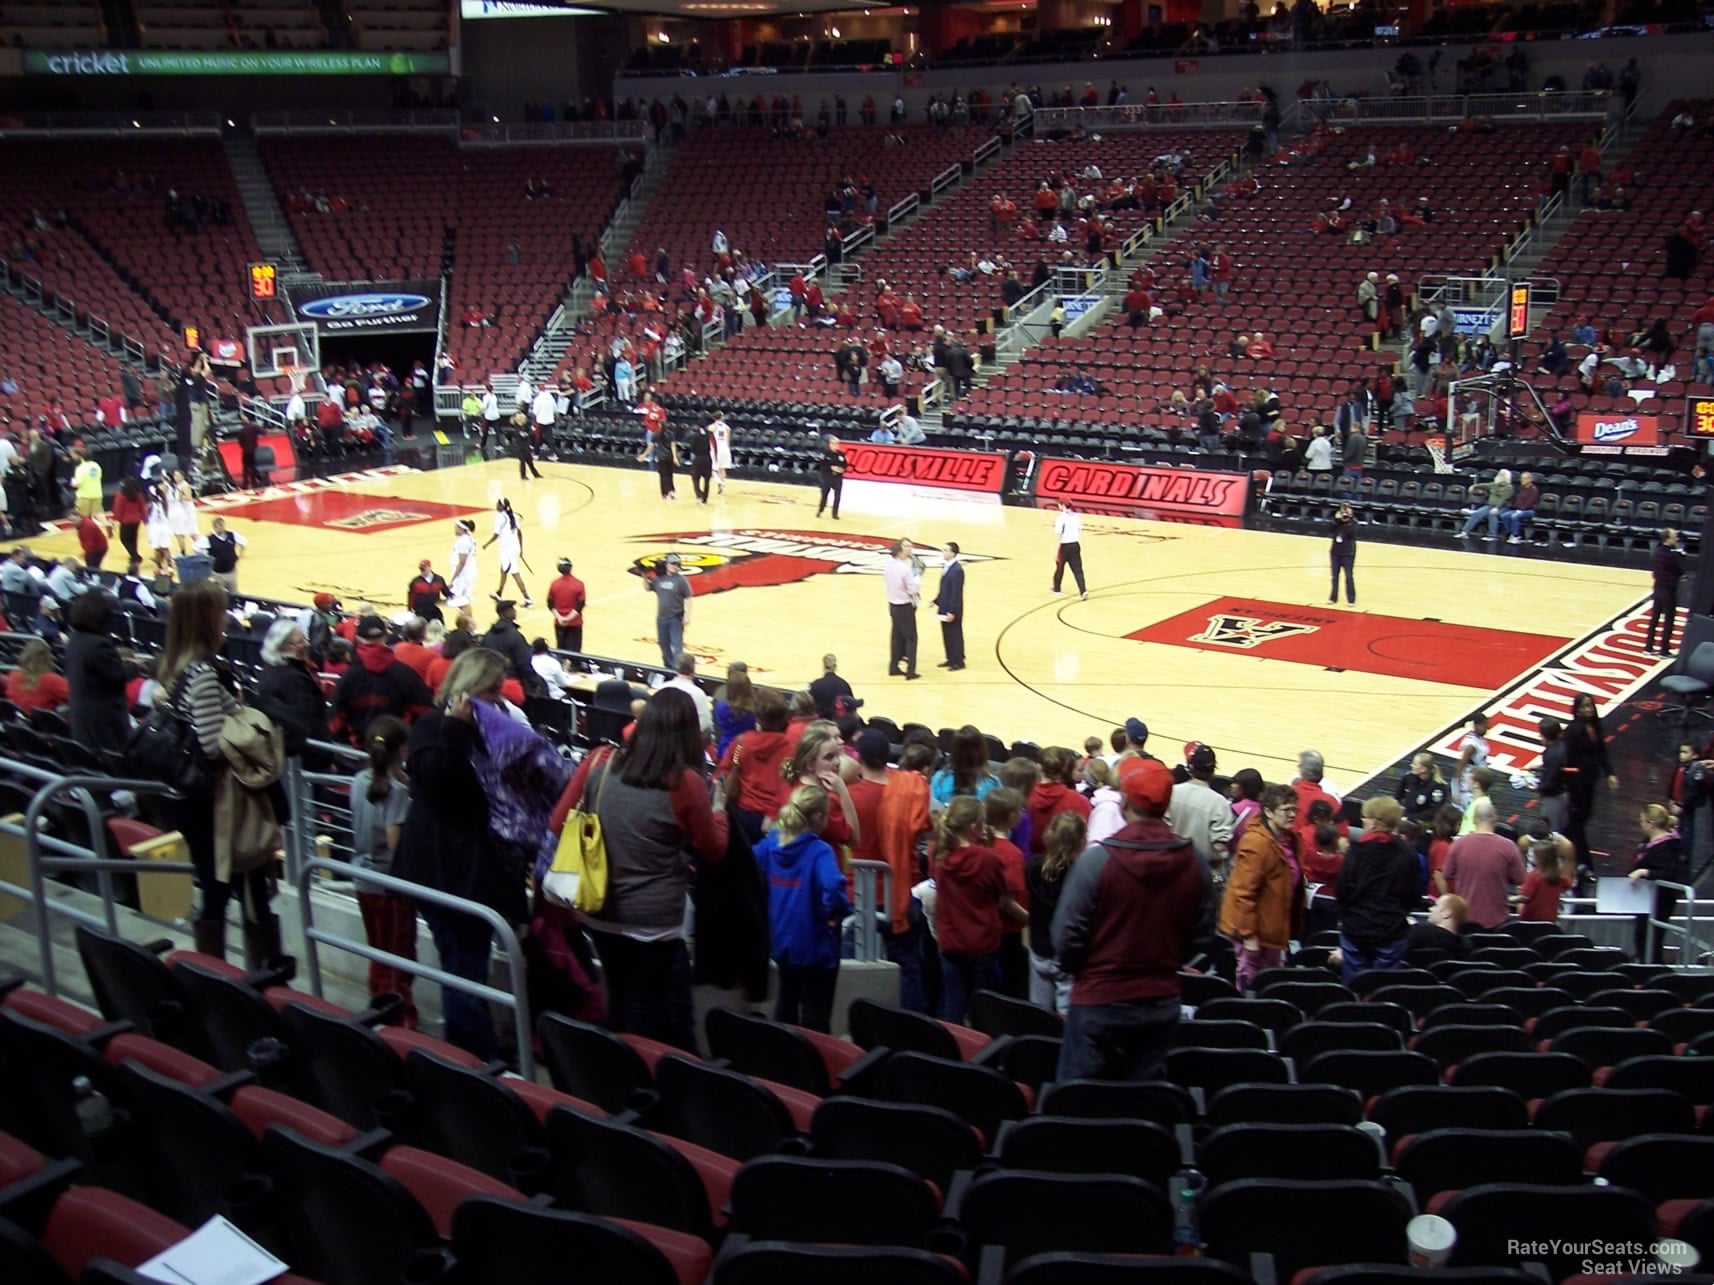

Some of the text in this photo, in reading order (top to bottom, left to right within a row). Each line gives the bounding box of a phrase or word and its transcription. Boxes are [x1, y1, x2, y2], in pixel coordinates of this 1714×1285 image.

[49, 52, 130, 74] cricket
[351, 56, 381, 70] PLAN
[327, 295, 404, 318] Ford
[355, 313, 419, 328] Further
[1594, 418, 1638, 439] Dean's
[843, 447, 996, 487] LOUISVILLE
[1043, 465, 1240, 508] CARDINALS
